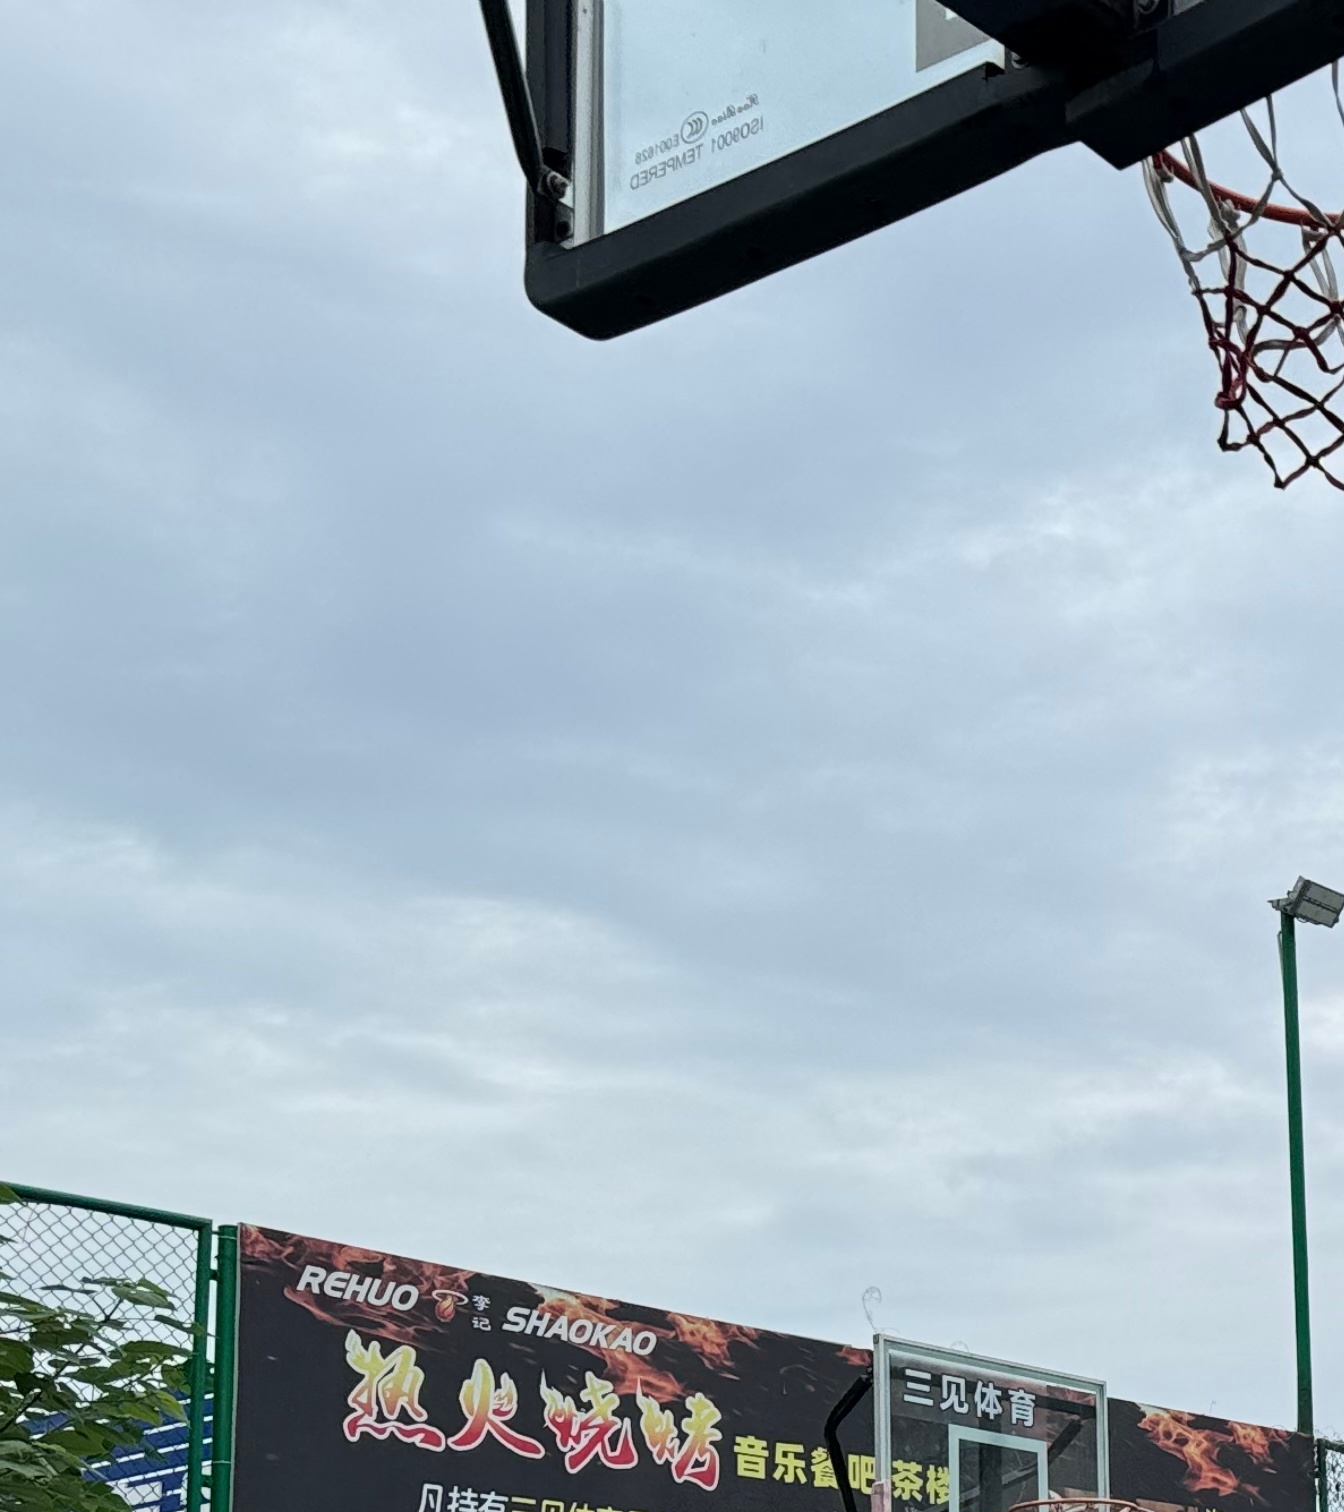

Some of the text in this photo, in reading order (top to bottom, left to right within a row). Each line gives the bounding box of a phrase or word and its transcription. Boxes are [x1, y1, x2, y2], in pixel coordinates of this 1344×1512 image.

[296, 1264, 420, 1312] REHUO
[502, 1306, 657, 1356] SHAOKAO
[903, 1368, 1037, 1428] 三见体育
